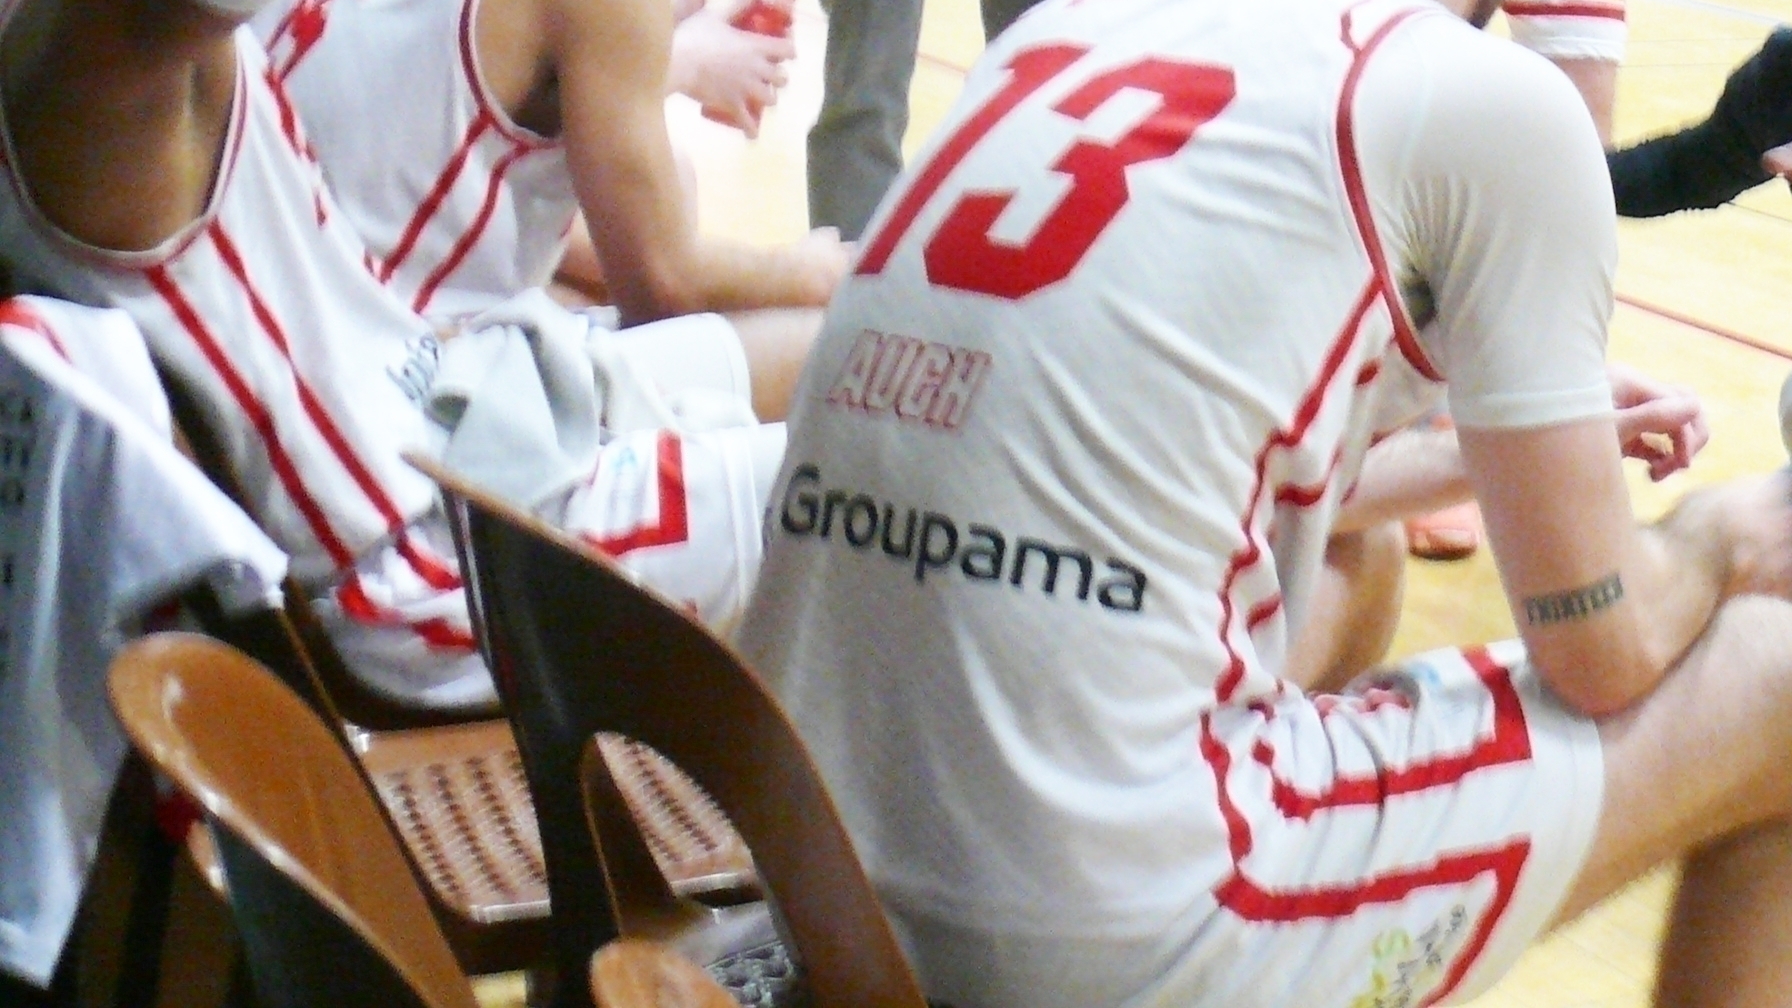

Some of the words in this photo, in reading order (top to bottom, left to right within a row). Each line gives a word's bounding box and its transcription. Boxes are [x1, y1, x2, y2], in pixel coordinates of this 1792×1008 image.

[855, 40, 1236, 300] 13
[826, 328, 994, 431] AUCH
[779, 462, 1149, 612] Groupama
